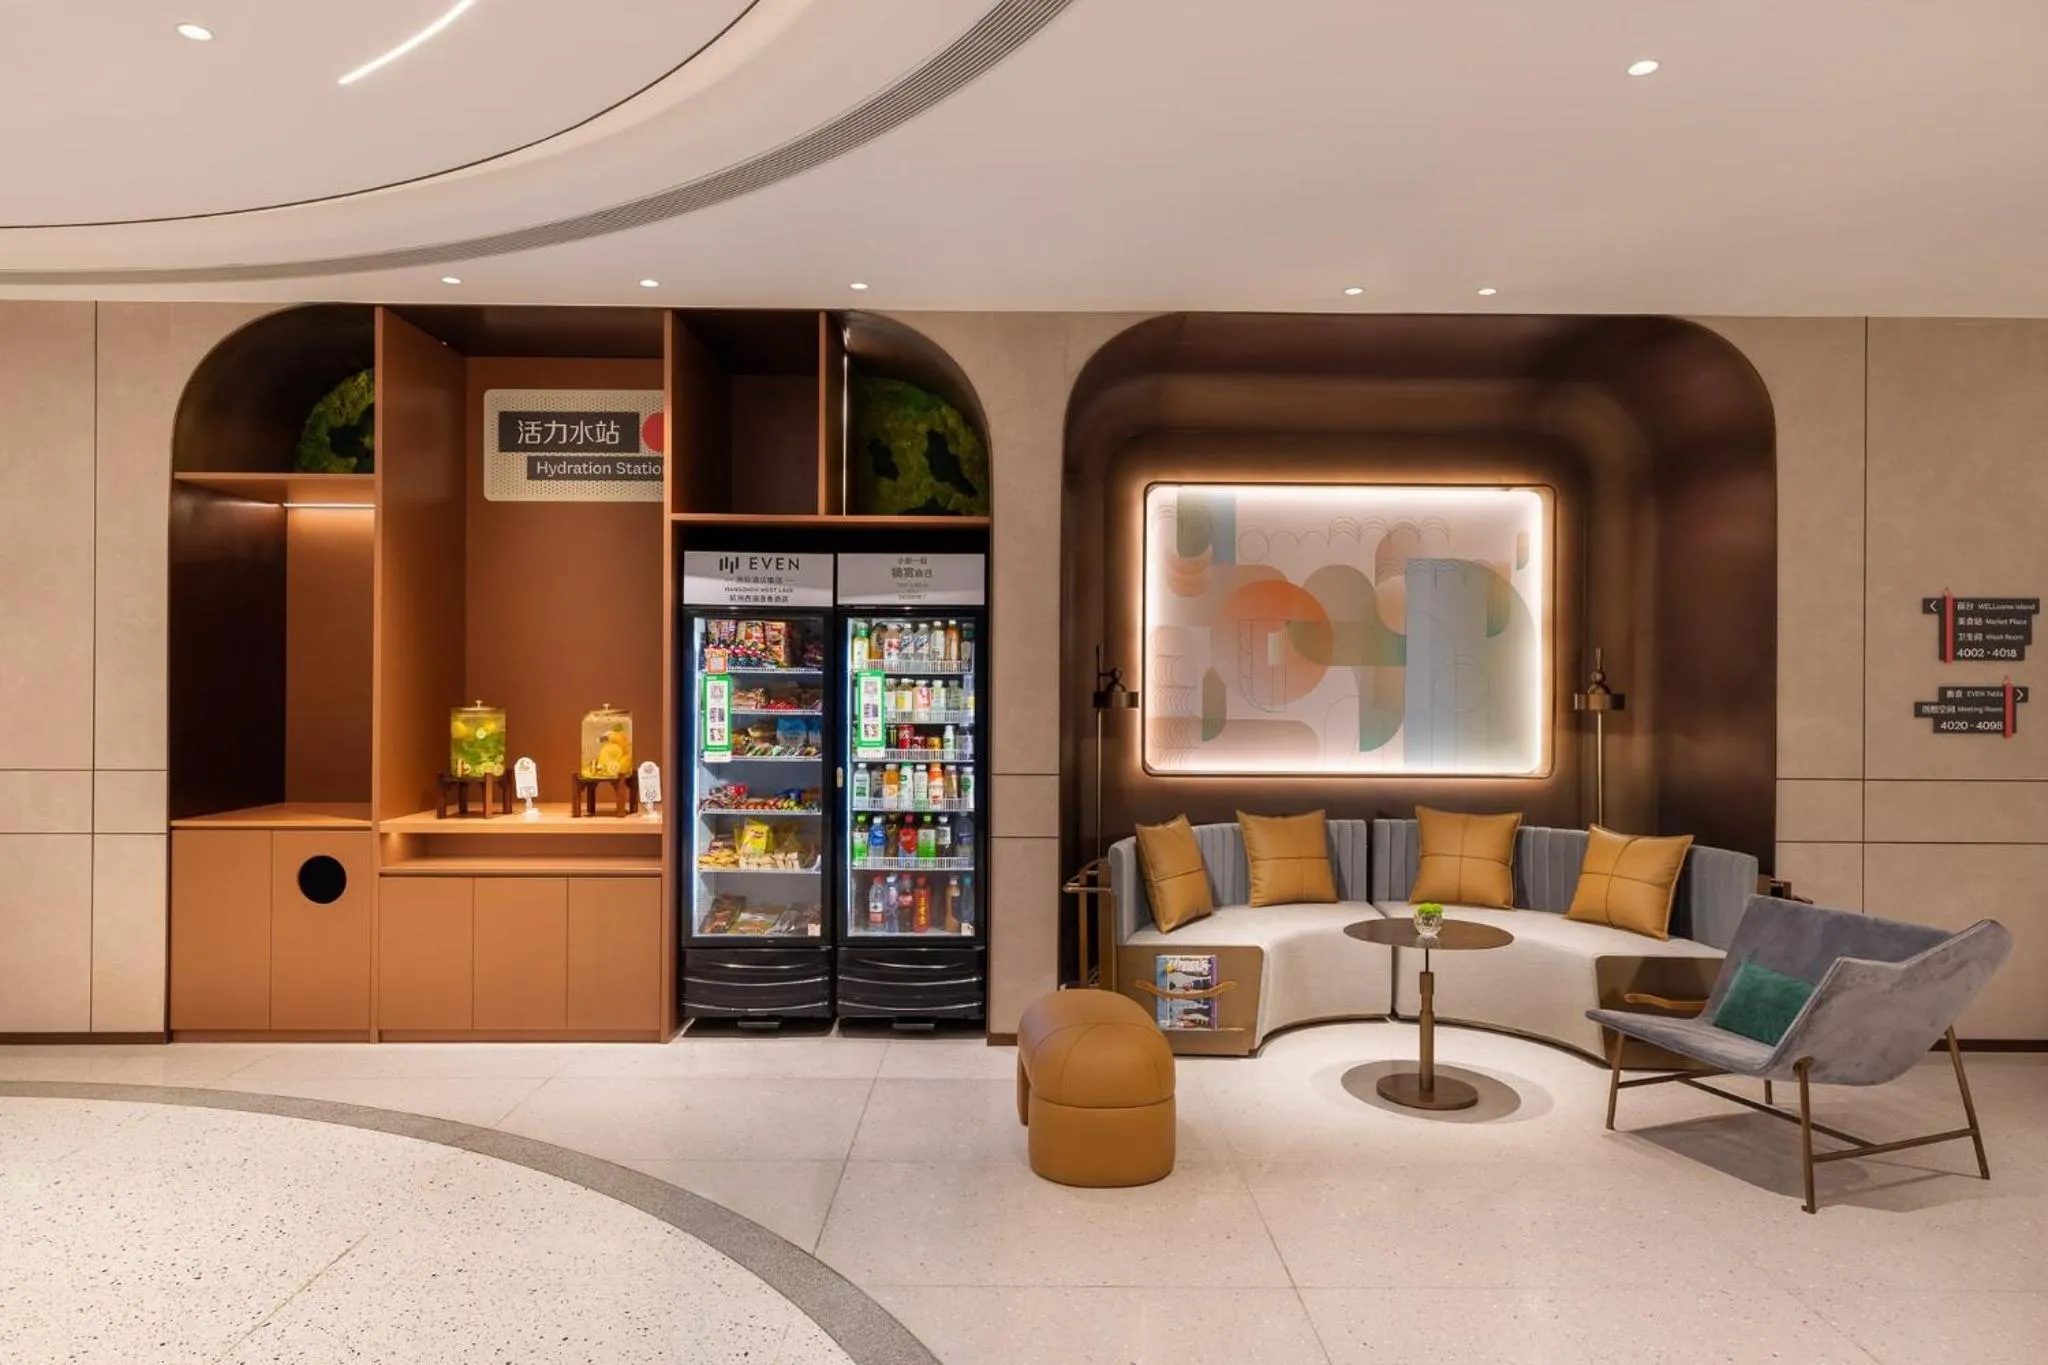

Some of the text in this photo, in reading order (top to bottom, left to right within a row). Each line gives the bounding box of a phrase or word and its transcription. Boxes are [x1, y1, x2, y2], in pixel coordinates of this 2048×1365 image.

[517, 420, 620, 445] 活力水站
[536, 461, 663, 477] Hydration Statio
[750, 556, 800, 570] EVEN
[1958, 632, 1983, 642] 卫生间
[1957, 648, 1985, 658] 4002
[1940, 721, 1969, 730] 4020
